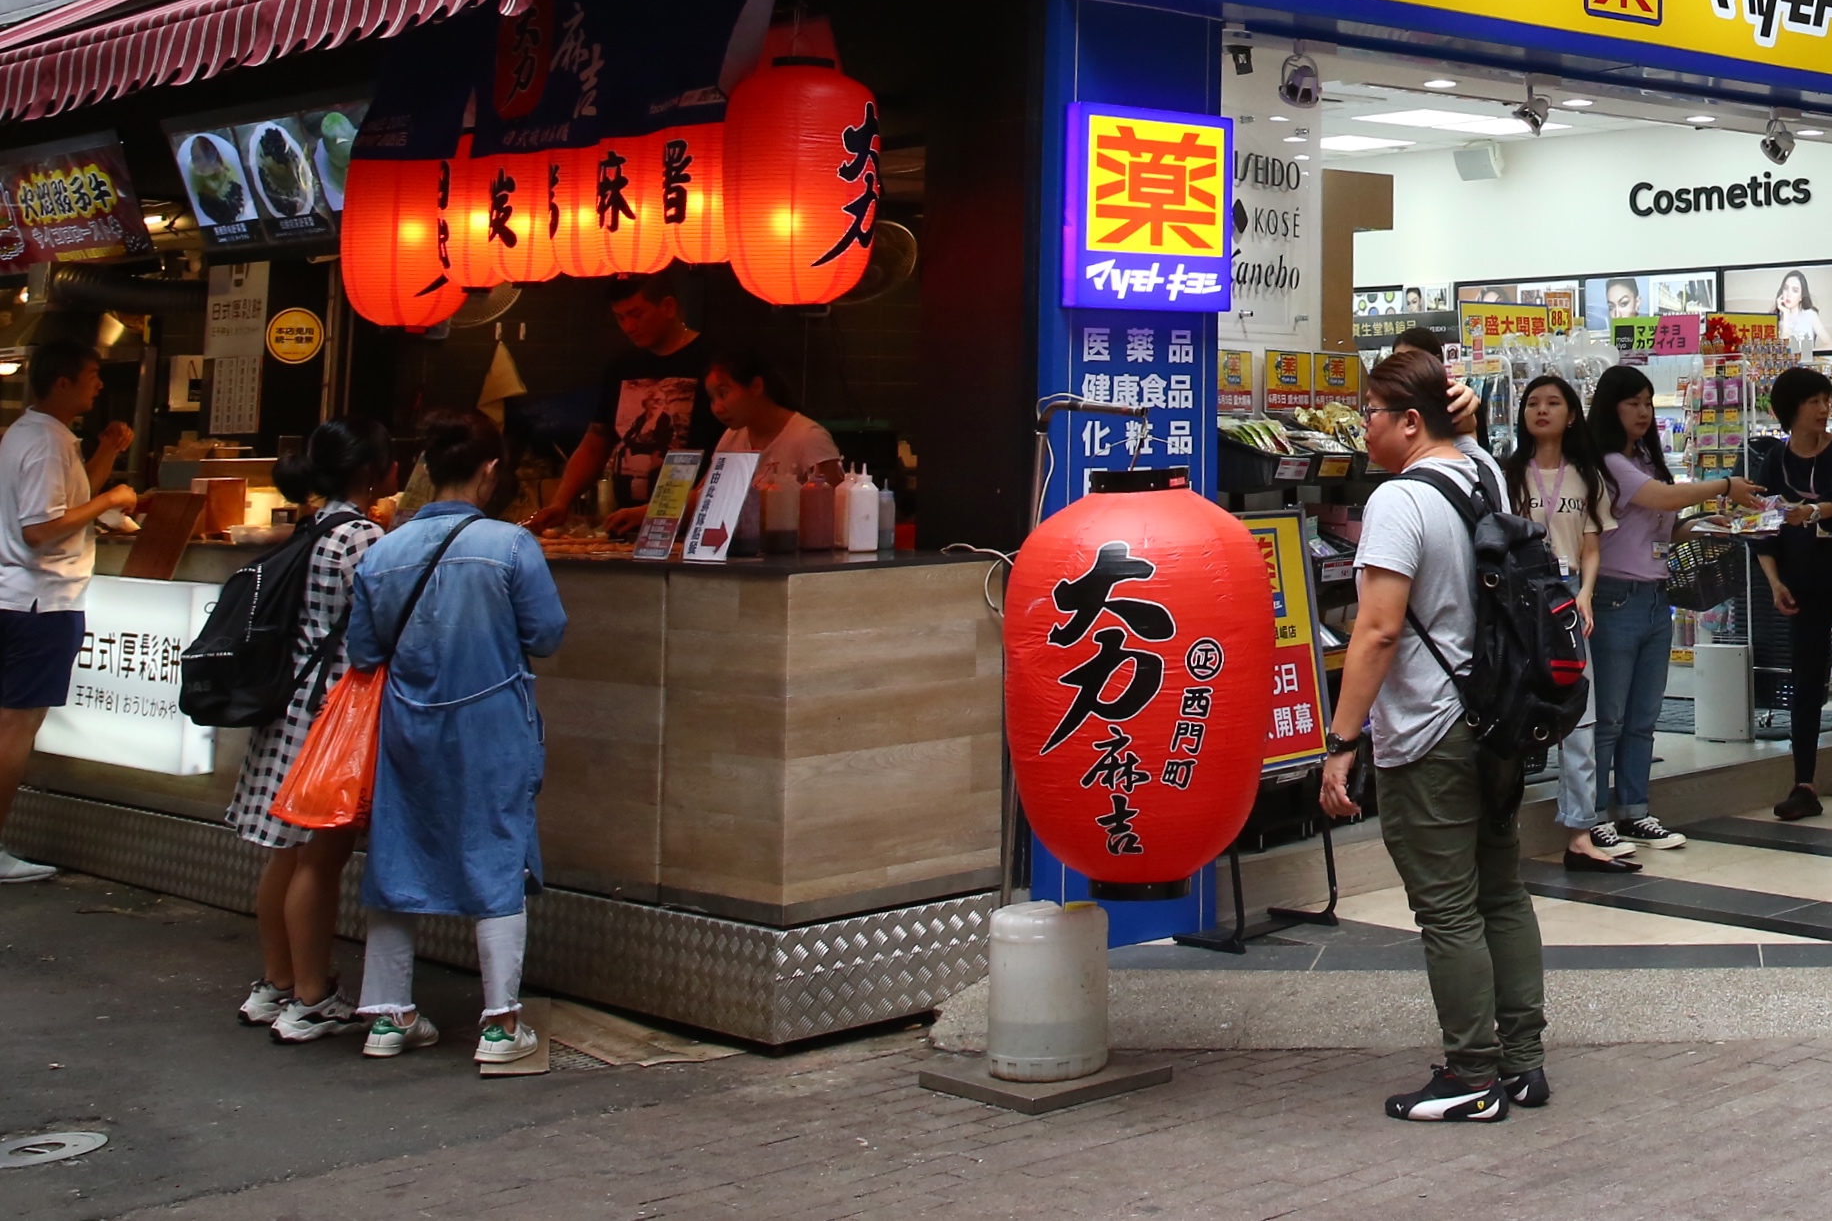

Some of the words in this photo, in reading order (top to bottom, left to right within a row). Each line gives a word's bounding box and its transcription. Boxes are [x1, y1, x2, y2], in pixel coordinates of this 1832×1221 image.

[1096, 125, 1217, 250] 薬
[1630, 172, 1812, 217] Cosmetics
[1254, 207, 1300, 238] KOSÉ
[1086, 258, 1222, 301] マツモトキヨシ
[1484, 314, 1547, 337] 盛大開幕
[1636, 324, 1681, 337] マツキヨ
[1637, 336, 1686, 350] カワイイヨ
[1733, 324, 1777, 340] 大開幕
[1082, 327, 1194, 364] 医薬品
[1081, 373, 1193, 410] 健康食品
[1268, 393, 1287, 405] 6月5日
[1082, 419, 1194, 457] 化粧品
[78, 632, 181, 685] 日式厚鬆餅
[75, 684, 114, 711] 王子神谷
[123, 694, 178, 720] おうじかみや
